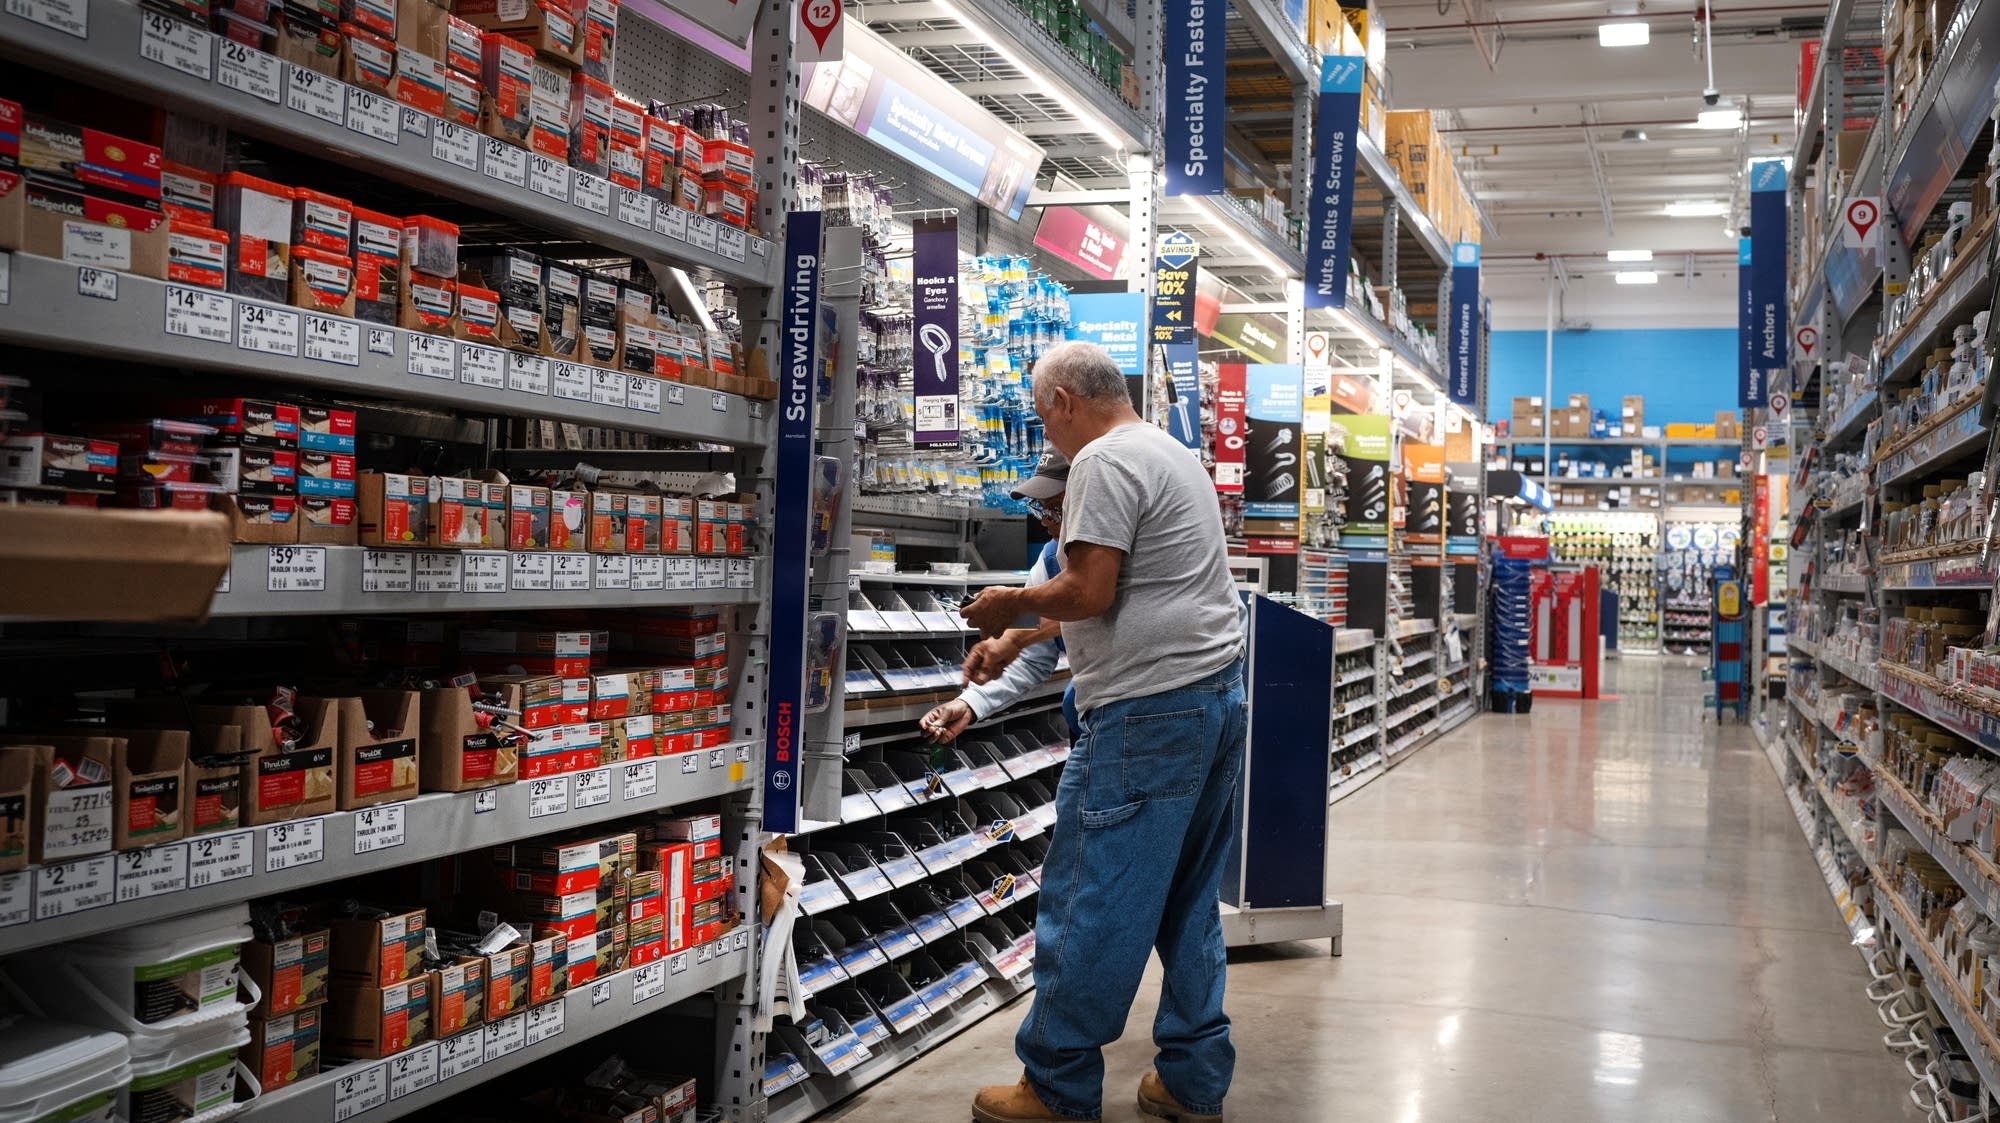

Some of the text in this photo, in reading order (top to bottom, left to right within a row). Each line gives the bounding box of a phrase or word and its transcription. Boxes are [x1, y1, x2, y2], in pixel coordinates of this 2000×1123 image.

[812, 5, 831, 19] 12
[1184, 72, 1208, 177] Specialty
[25, 122, 82, 148] LedgerLOK
[27, 194, 84, 216] LedgerLOK
[1318, 131, 1345, 296] Nuts, Bolts & Screws
[1858, 210, 1866, 220] 9
[1161, 246, 1195, 254] SAVINGS
[916, 276, 955, 285] Hooks &
[1158, 268, 1189, 281] Save
[925, 287, 947, 295] Eyes
[1157, 280, 1185, 296] 10%
[1079, 321, 1138, 333] Specialty
[1762, 303, 1775, 359] Anchors
[786, 253, 816, 423] Screwdriving
[1102, 332, 1137, 342] Metal
[1154, 331, 1172, 340] 10%
[1457, 303, 1471, 397] General Hardware
[776, 702, 792, 763] BOSCH
